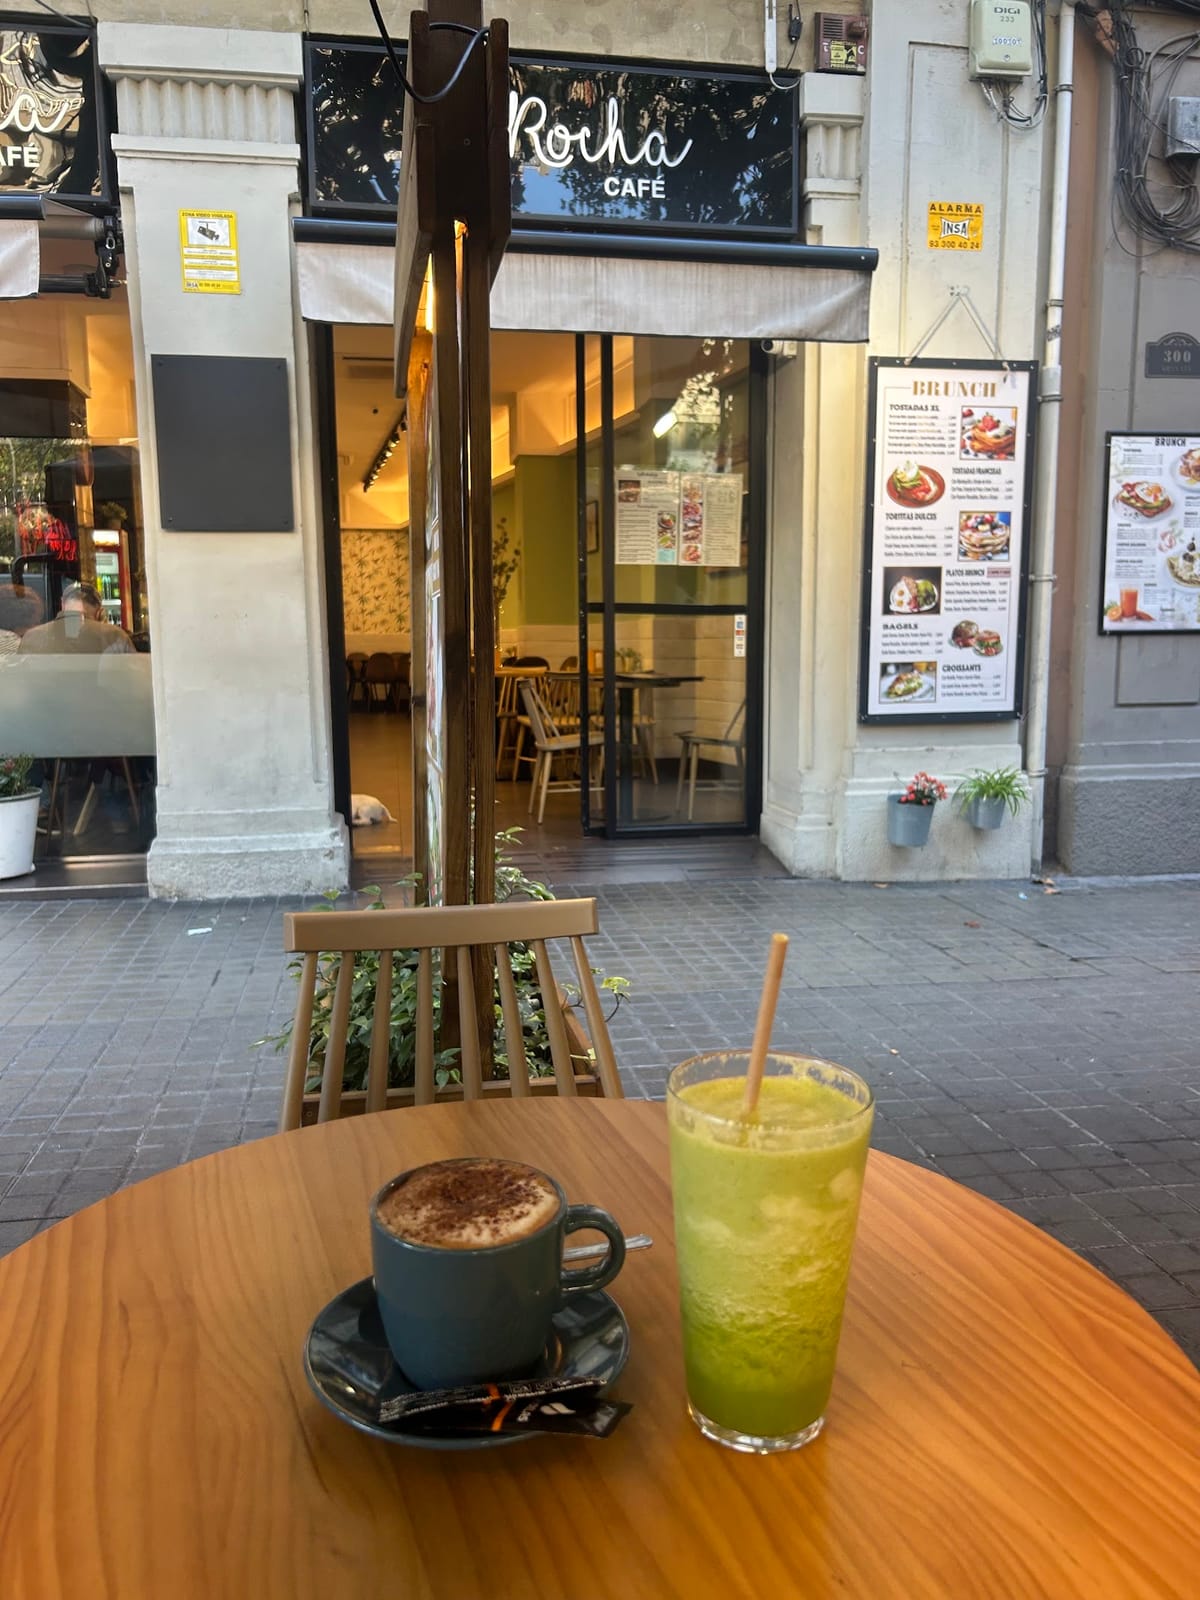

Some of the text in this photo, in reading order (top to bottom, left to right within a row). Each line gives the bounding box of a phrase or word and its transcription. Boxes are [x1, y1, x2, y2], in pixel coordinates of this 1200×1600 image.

[508, 90, 693, 168] Rocha
[604, 175, 666, 199] CAFÉ
[930, 203, 982, 213] ALARMA
[943, 221, 967, 236] INSA
[941, 240, 956, 248] 300
[958, 241, 968, 249] 40
[1164, 350, 1191, 362] 300
[913, 380, 997, 397] BRUNCH
[889, 404, 929, 412] TOSTADAS
[1155, 438, 1187, 447] BRUNCH
[942, 664, 982, 673] CROISSANTS
